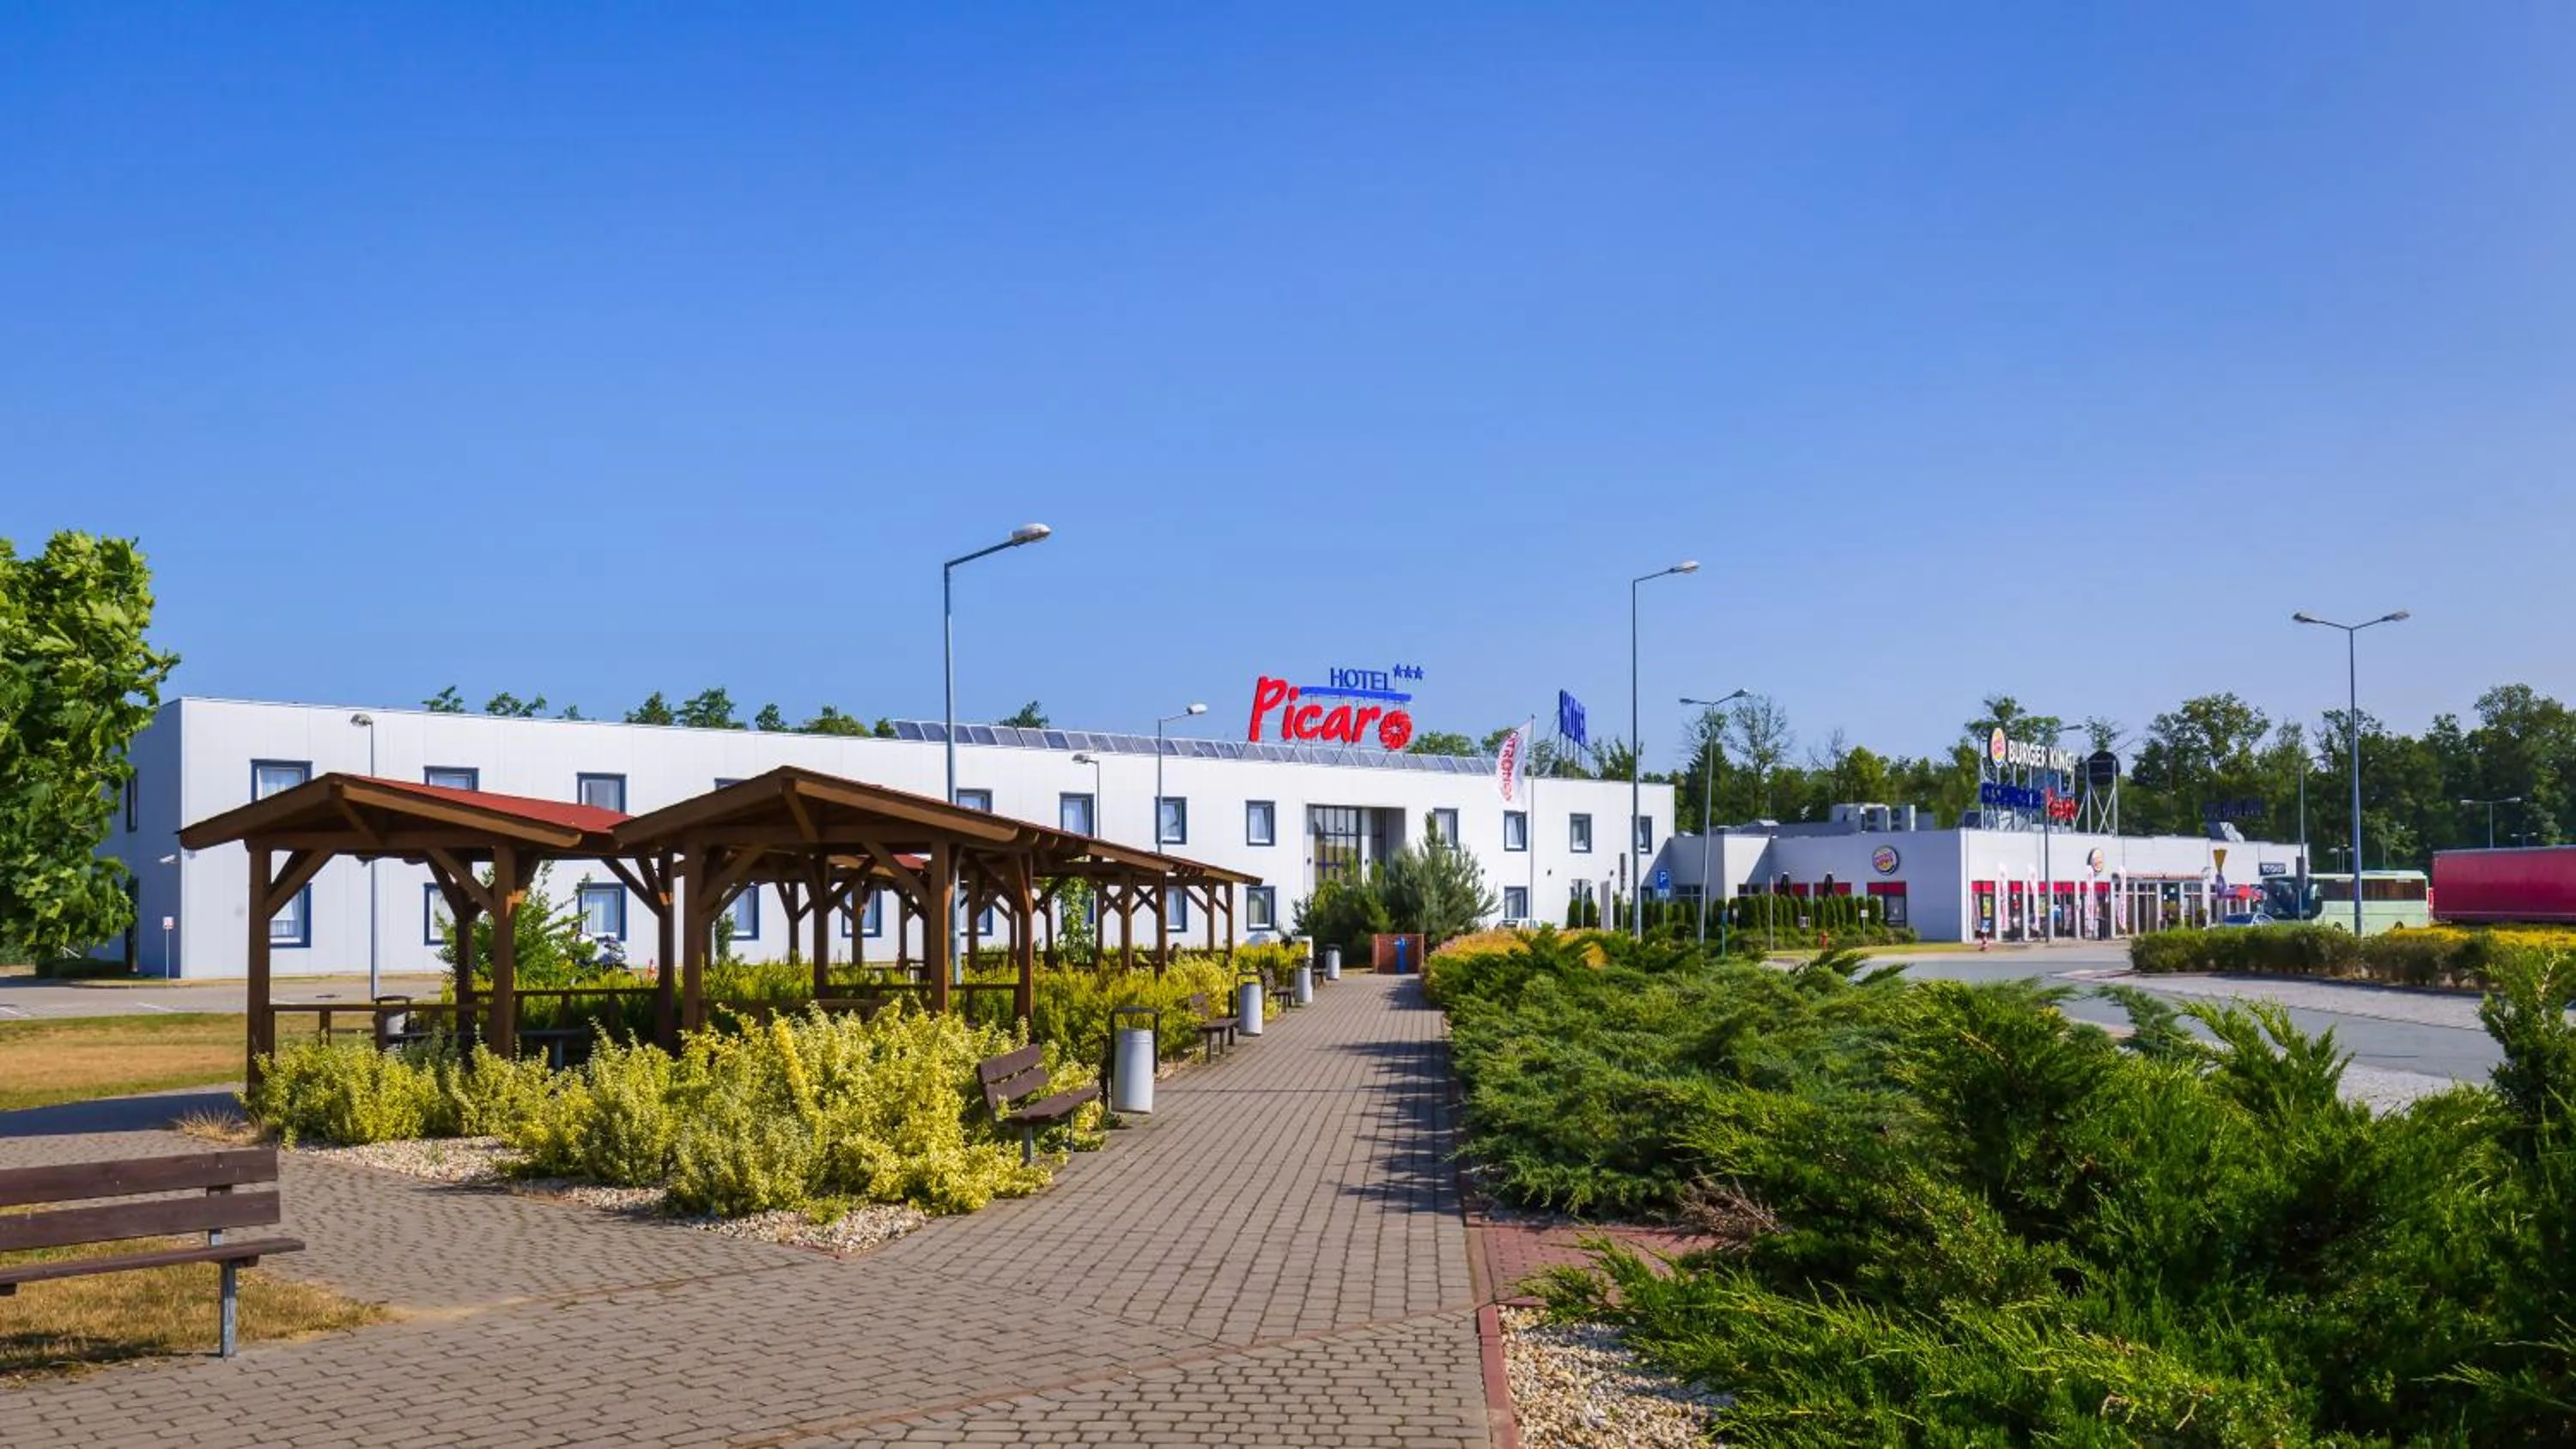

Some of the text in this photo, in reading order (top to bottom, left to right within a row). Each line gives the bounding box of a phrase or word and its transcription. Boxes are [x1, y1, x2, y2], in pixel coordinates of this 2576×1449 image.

[1330, 667, 1395, 691] HOTEL
[1249, 676, 1413, 749] Picaro
[2008, 739, 2047, 767] BURGER
[2049, 746, 2075, 772] KING
[1660, 871, 1667, 883] P
